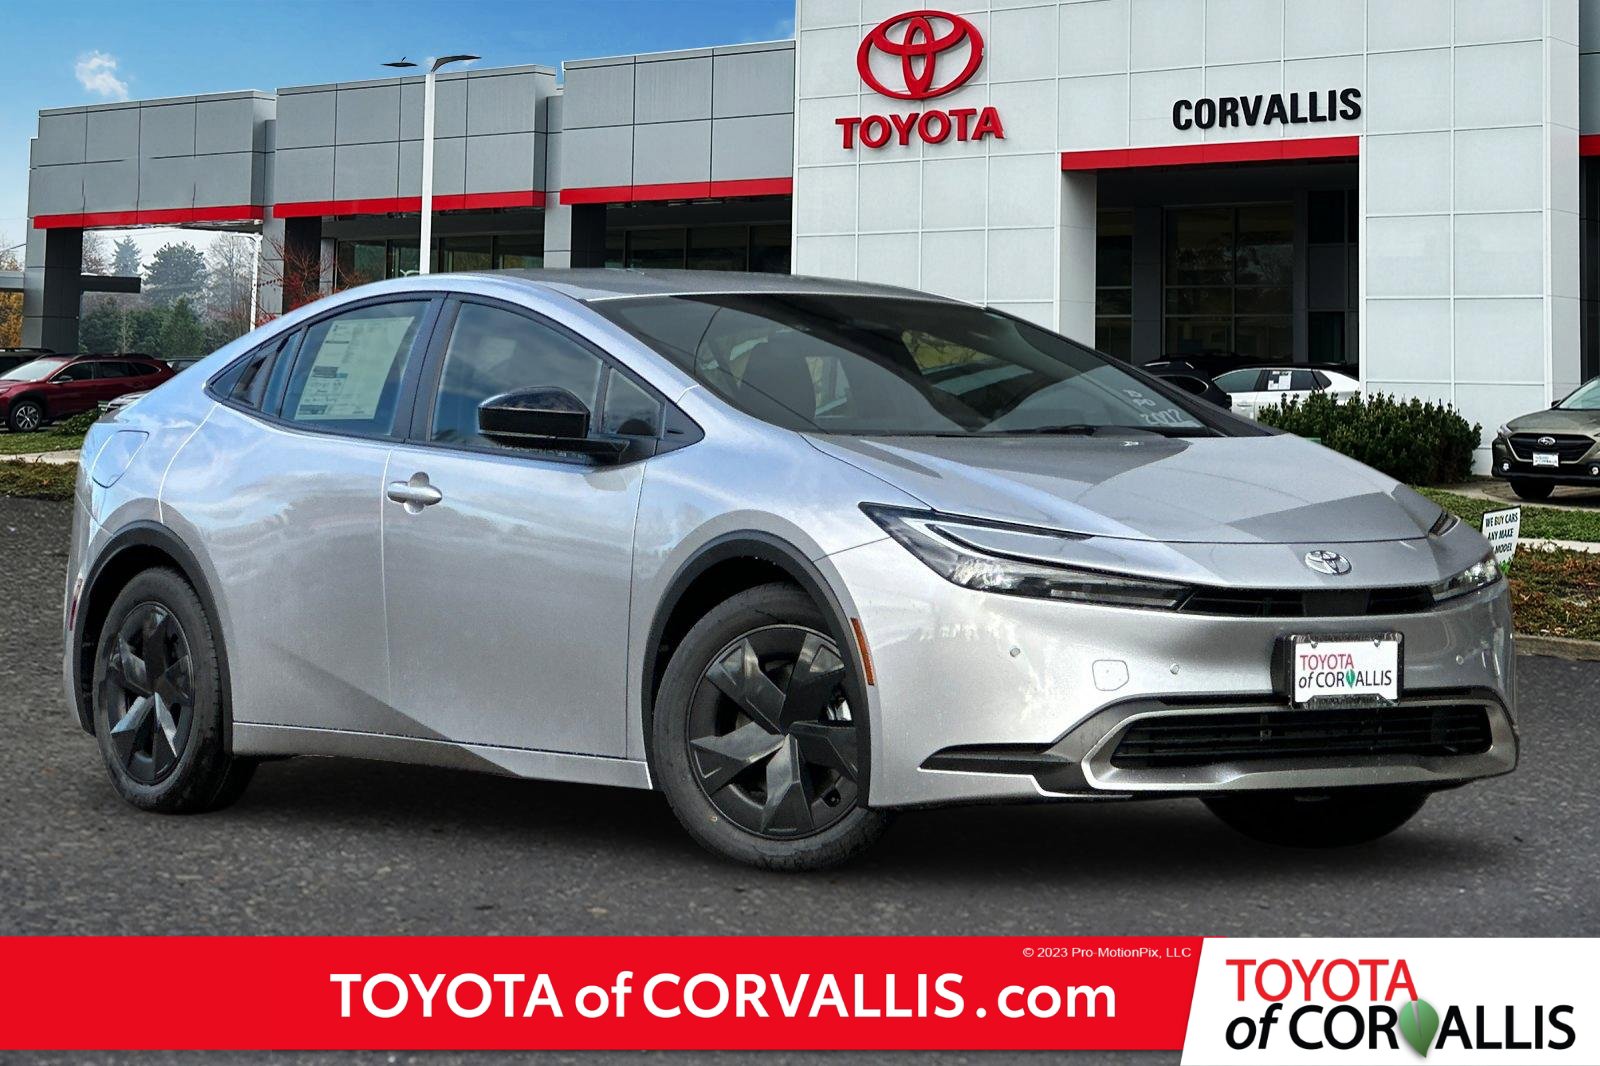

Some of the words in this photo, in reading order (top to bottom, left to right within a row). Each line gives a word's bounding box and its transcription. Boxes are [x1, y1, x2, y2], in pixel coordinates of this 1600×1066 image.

[1172, 88, 1362, 131] CORVALLIS
[835, 107, 1006, 150] TOYOTA
[1494, 515, 1504, 526] BUY
[1505, 512, 1518, 524] CARS
[1487, 530, 1498, 541] ANY
[1498, 528, 1514, 540] MAKE
[1300, 653, 1355, 671] TOYOTA
[1298, 671, 1315, 688] of
[1316, 668, 1392, 689] CORALLIS
